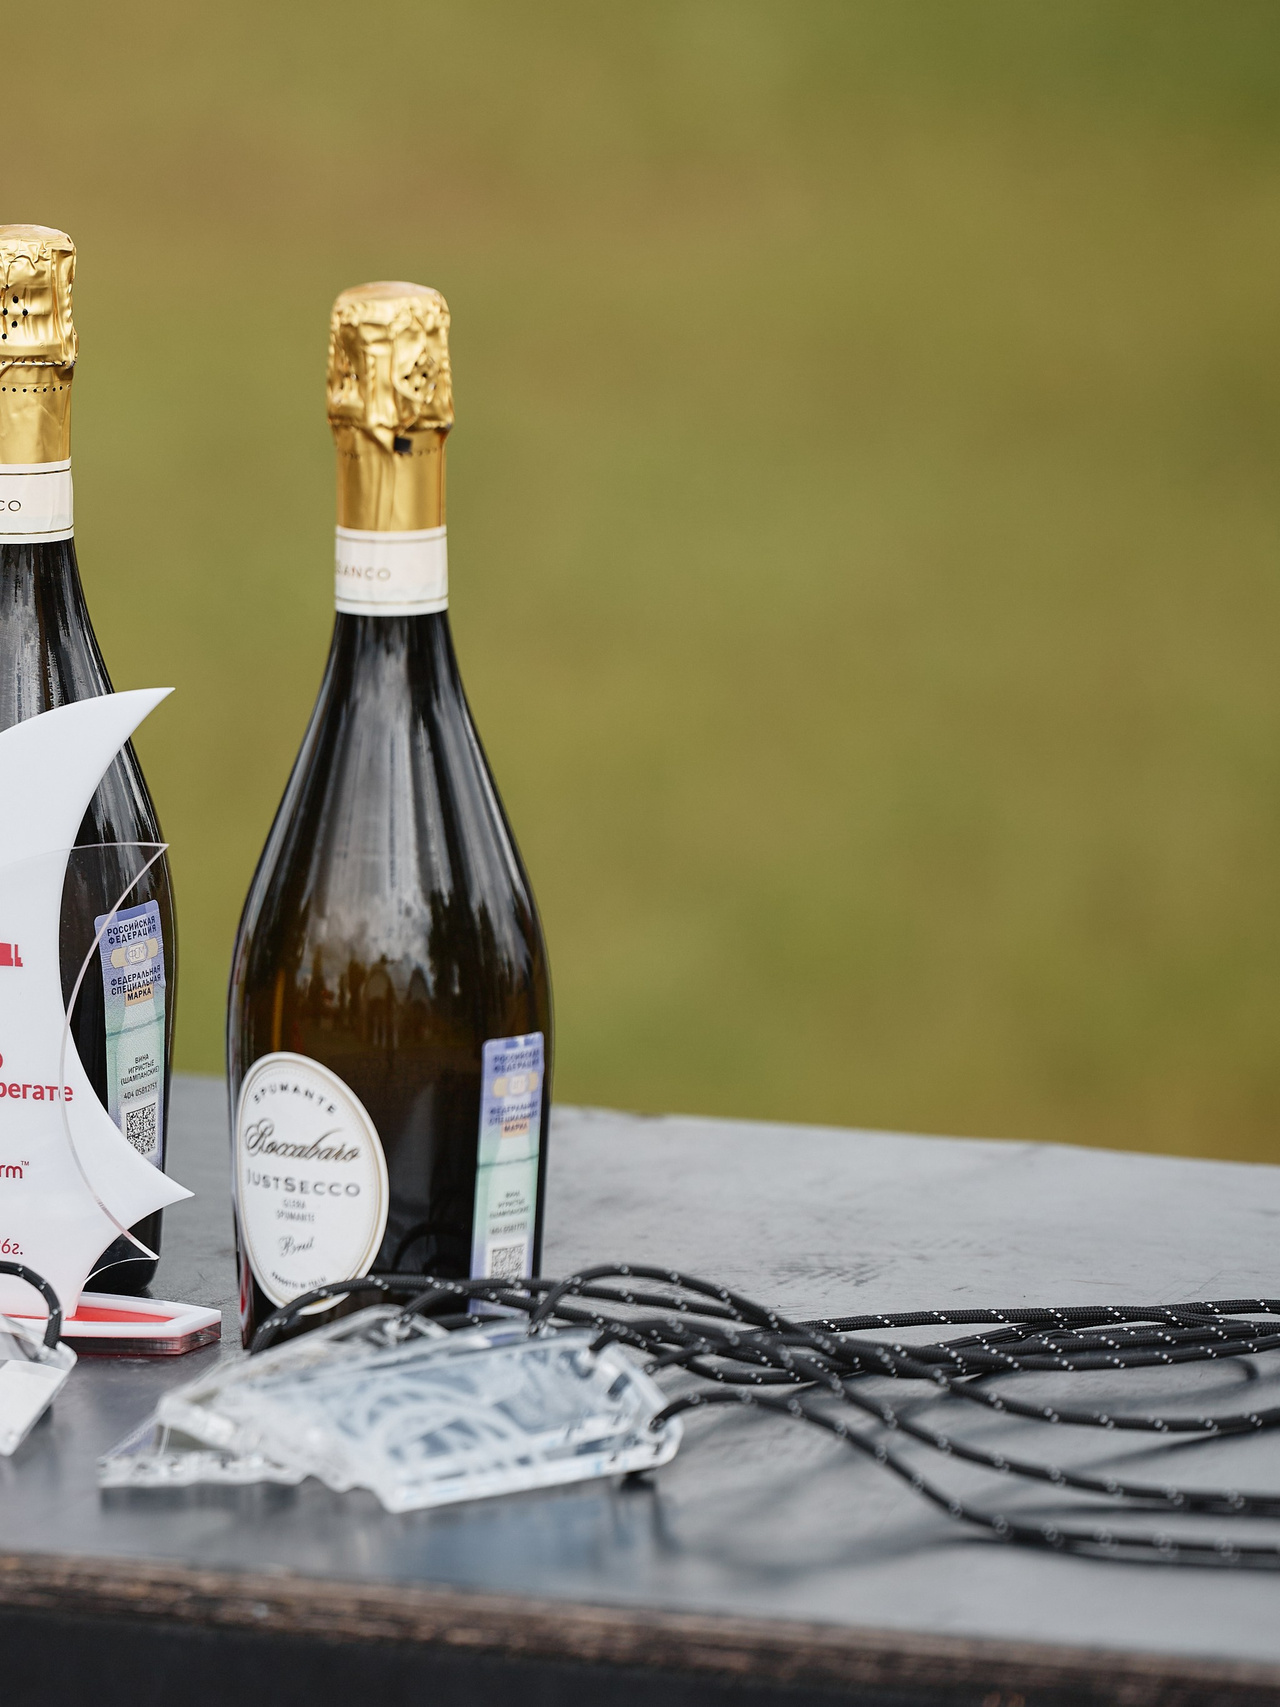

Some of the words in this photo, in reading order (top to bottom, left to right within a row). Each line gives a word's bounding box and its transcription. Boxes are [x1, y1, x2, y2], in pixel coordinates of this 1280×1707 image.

[107, 916, 156, 936] РОССИЙСКАЯ
[108, 924, 157, 944] ФЕДЕРАЦИЯ
[111, 965, 160, 986] ФЕДЕРАЛЬНАЯ
[112, 974, 161, 996] СПЕЦИАЛЬНАЯ
[127, 988, 152, 1002] МАРКА
[253, 1082, 336, 1115] SPUMANTE
[245, 1118, 360, 1162] Roccabaro
